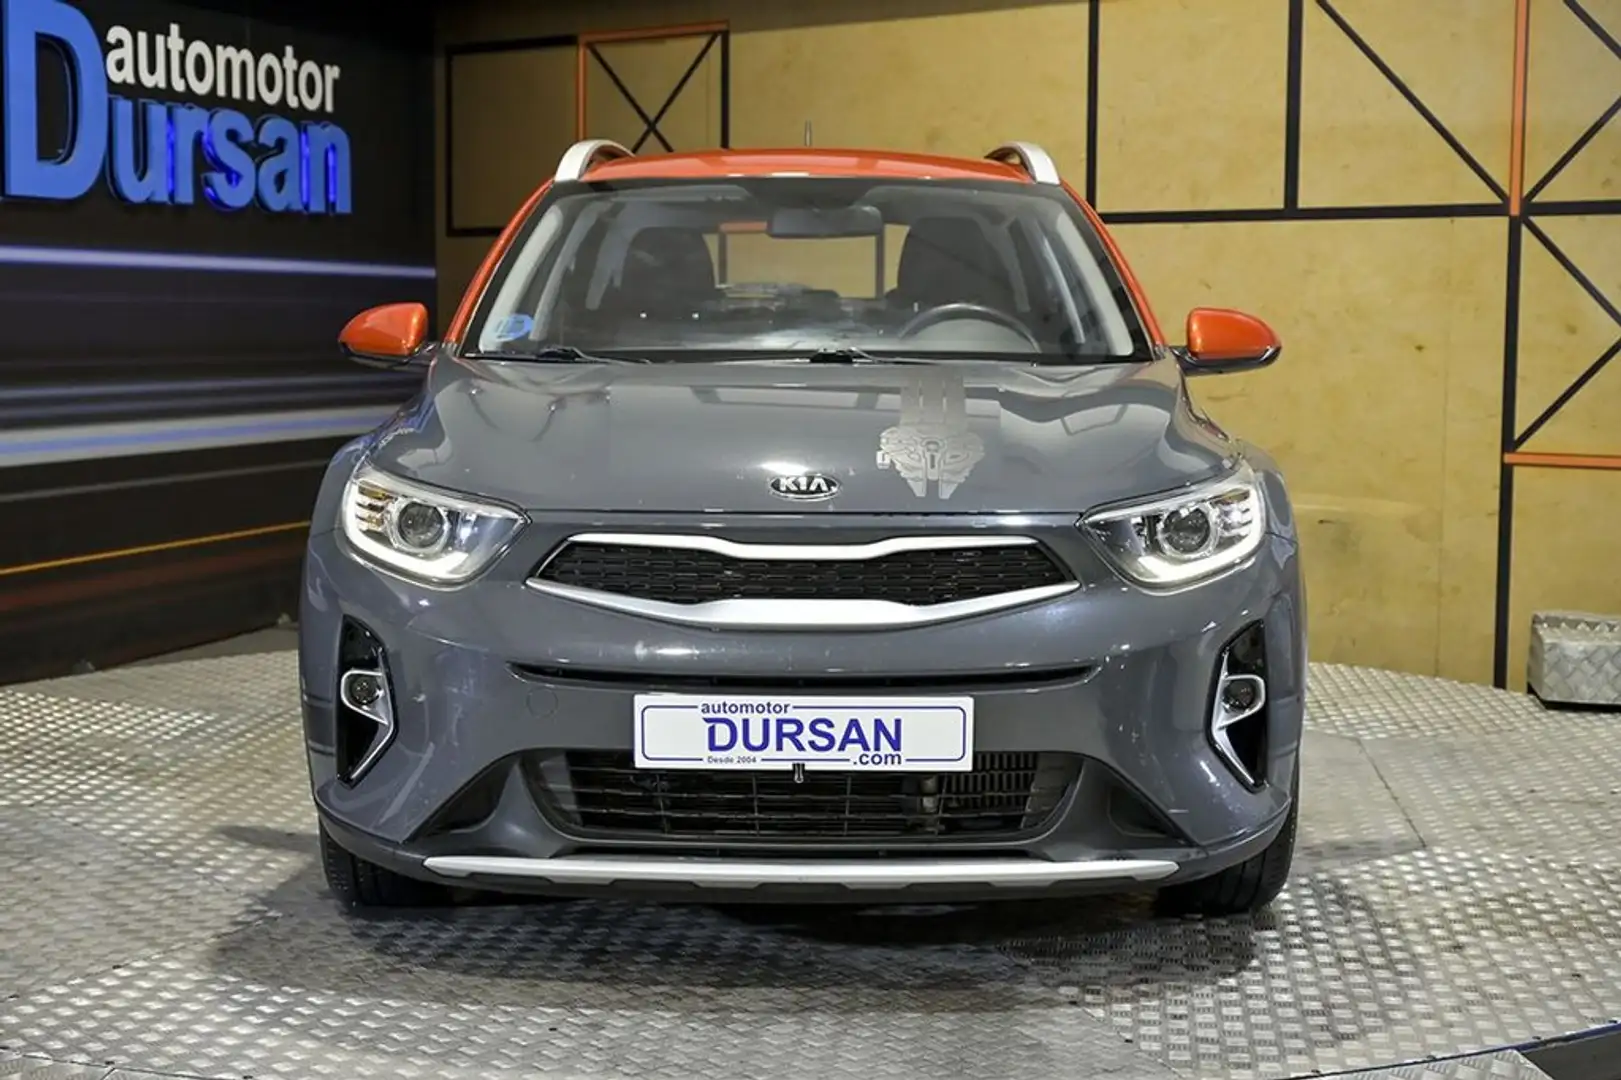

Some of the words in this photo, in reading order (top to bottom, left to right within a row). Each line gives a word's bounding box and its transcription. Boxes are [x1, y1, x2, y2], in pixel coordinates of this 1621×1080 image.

[105, 23, 340, 113] automotor
[4, 0, 352, 214] Dursan
[779, 476, 829, 491] KIA
[701, 701, 790, 715] automotor
[703, 718, 902, 752] DURSAN
[707, 755, 734, 764] Desde
[852, 751, 901, 766] .com
